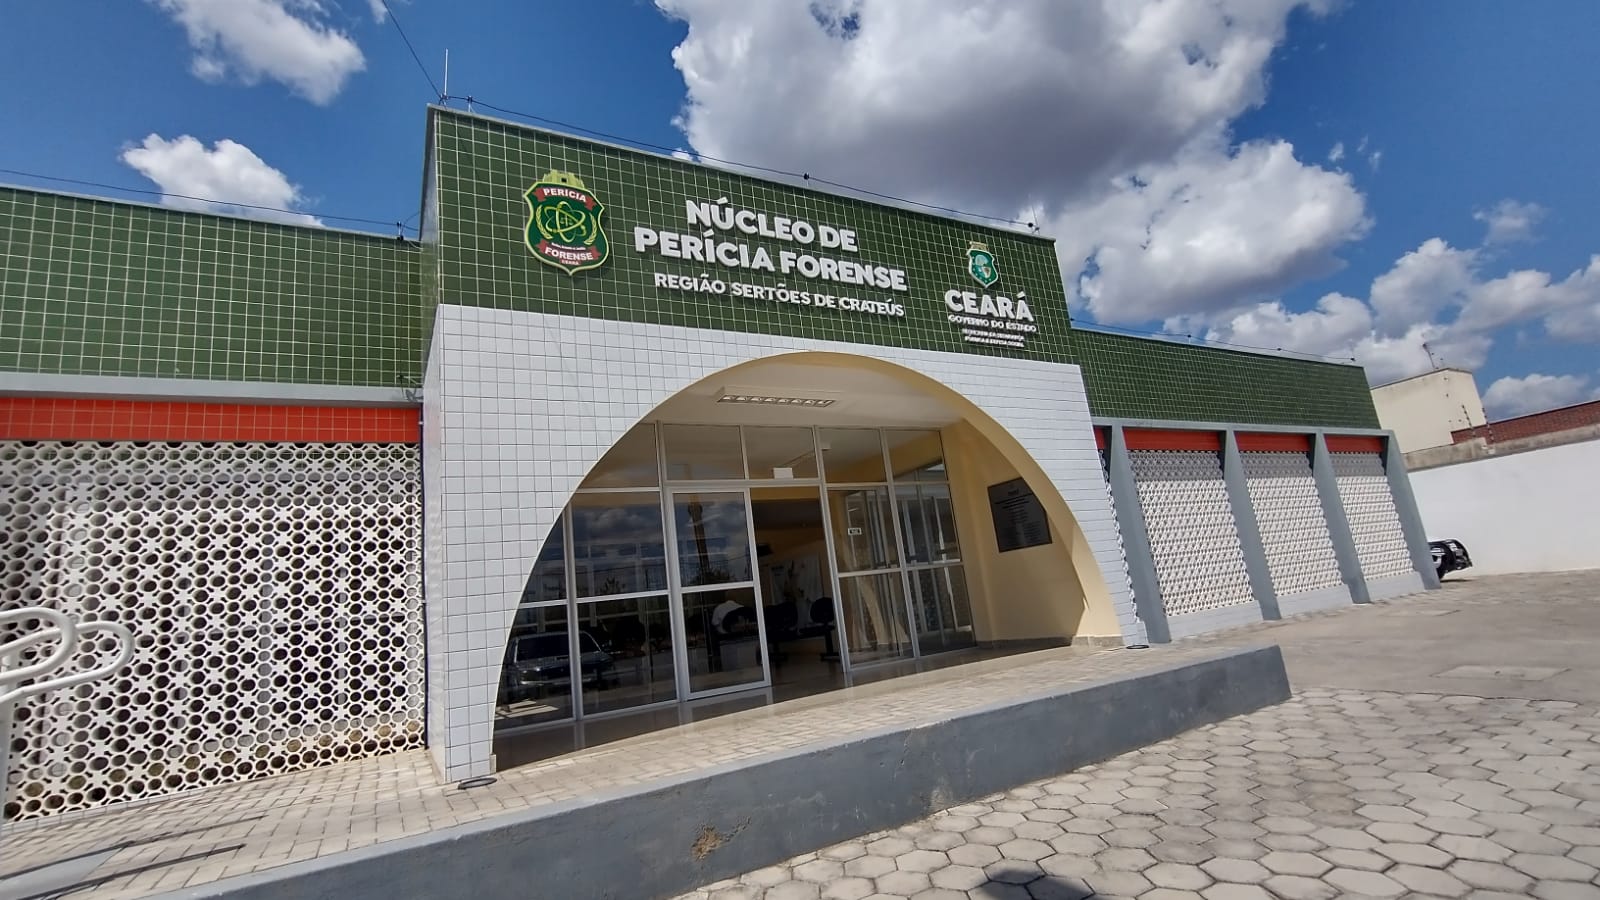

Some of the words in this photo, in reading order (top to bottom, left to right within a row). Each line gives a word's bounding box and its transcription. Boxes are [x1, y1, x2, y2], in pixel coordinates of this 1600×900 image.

[685, 196, 815, 244] NÚCLEO
[818, 224, 858, 252] DE
[545, 246, 594, 261] FORENSE
[634, 227, 775, 272] PERÍCIA
[780, 250, 908, 292] FORENSE
[654, 272, 726, 295] REGIÃO
[730, 282, 811, 306] SERTÕES
[813, 292, 836, 309] DE
[838, 297, 905, 317] CRATEÚS
[944, 289, 1034, 322] CEARÁ
[990, 319, 1005, 329] DO
